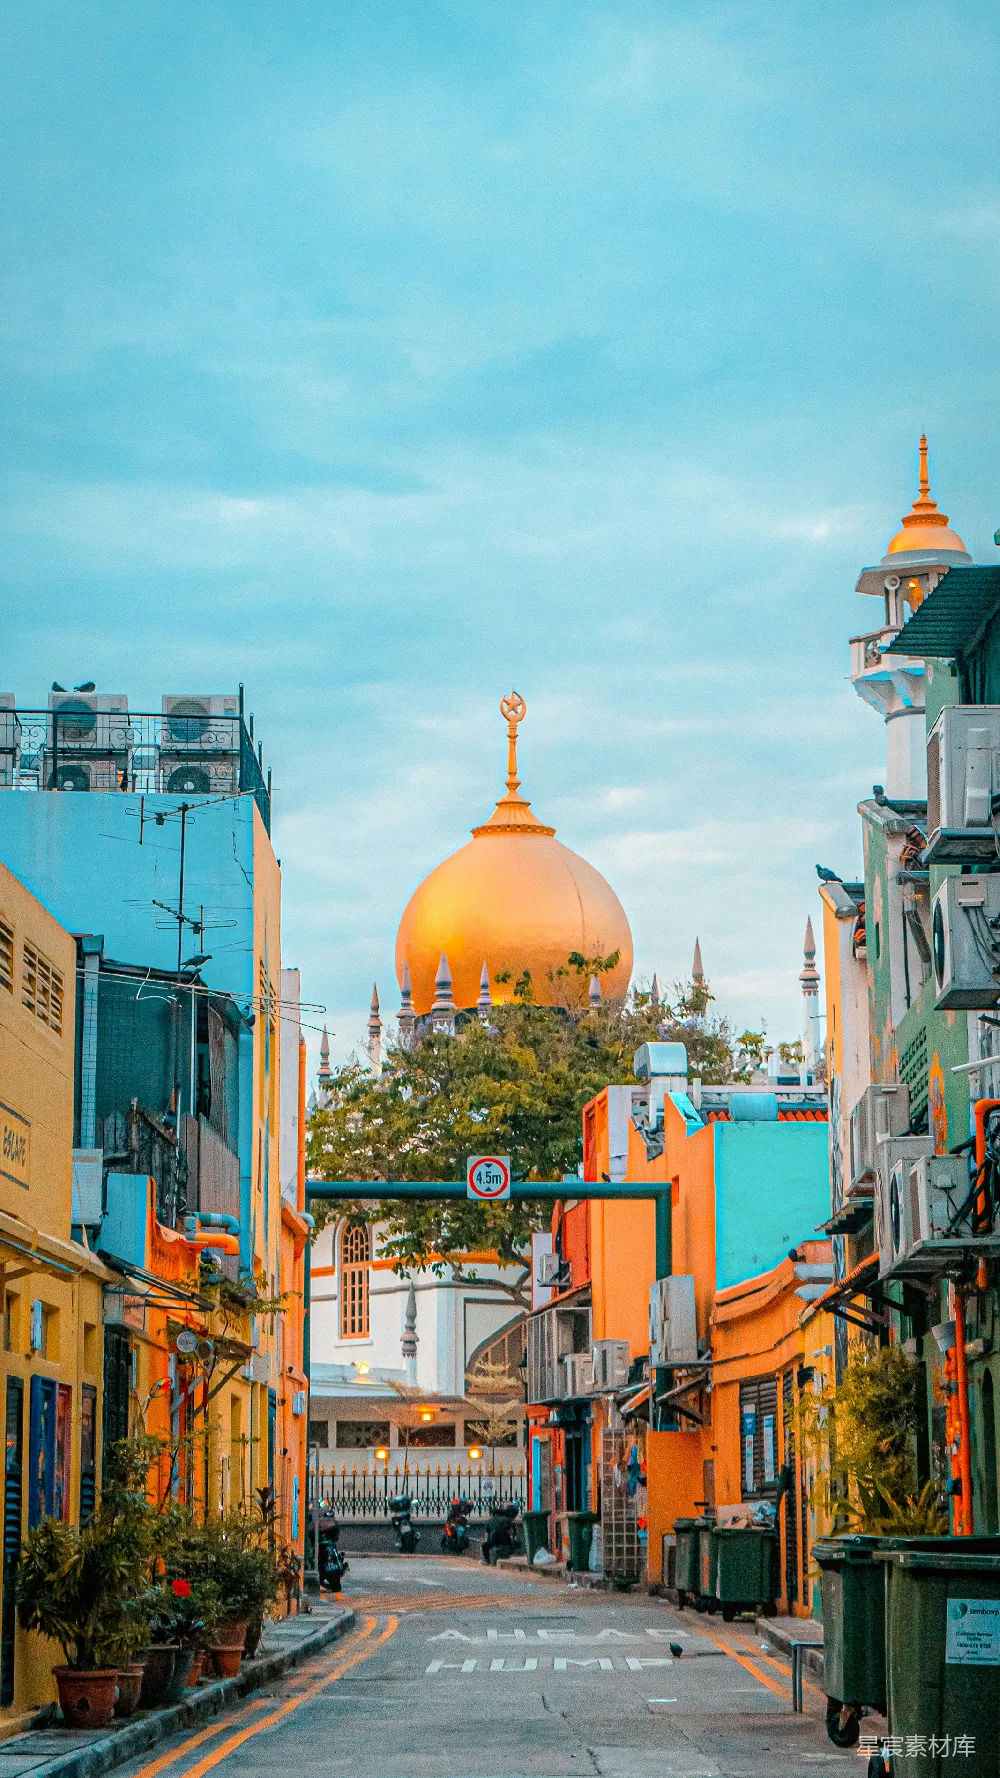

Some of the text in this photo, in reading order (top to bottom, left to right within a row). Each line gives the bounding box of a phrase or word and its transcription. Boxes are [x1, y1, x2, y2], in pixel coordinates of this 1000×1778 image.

[476, 1170, 502, 1184] 4.5m
[426, 1628, 690, 1642] AHEAD
[424, 1658, 674, 1673] HUMP
